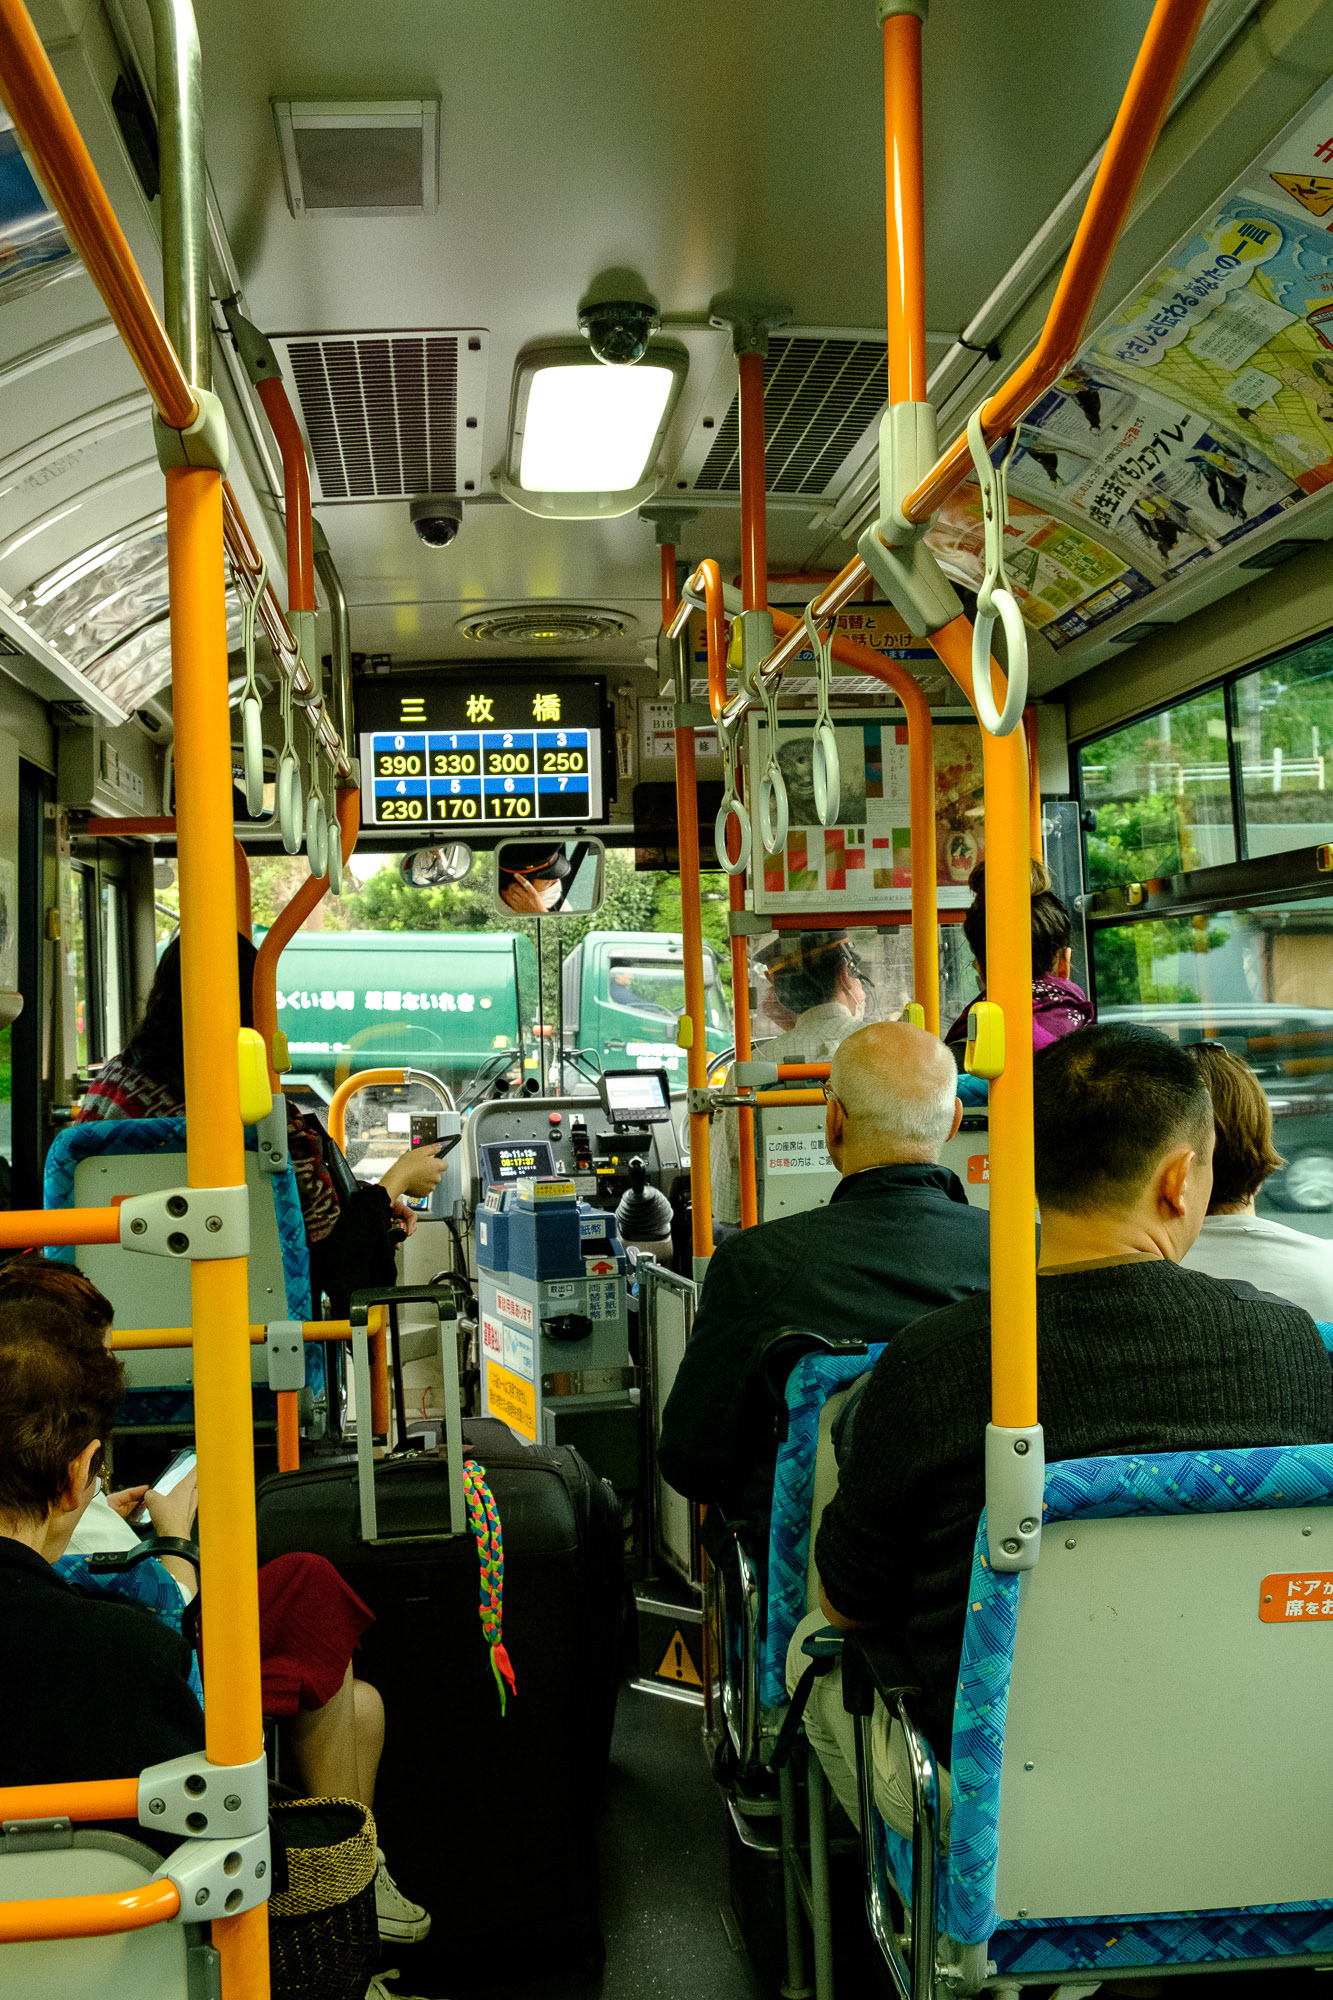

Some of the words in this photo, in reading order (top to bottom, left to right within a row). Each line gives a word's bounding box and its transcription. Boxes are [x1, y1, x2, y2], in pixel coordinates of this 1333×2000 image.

[842, 633, 914, 647] 話しかけ
[400, 693, 562, 723] 三枚橋
[394, 736, 405, 749] 0
[450, 736, 458, 748] 1
[503, 734, 513, 748] 2
[557, 733, 567, 747] 3
[380, 755, 421, 775] 390
[434, 754, 475, 774] 330
[489, 753, 529, 773] 300
[543, 752, 583, 772] 250
[396, 781, 407, 795] 4
[450, 780, 461, 793] 5
[504, 778, 515, 792] 6
[558, 777, 568, 791] 7
[381, 800, 422, 820] 230
[436, 799, 476, 818] 170
[491, 798, 531, 817] 170
[768, 1140, 827, 1152] この座席は、位置
[550, 1284, 573, 1293] 取出口
[588, 1284, 601, 1319] 両替紙幣
[604, 1282, 617, 1318] 運賃紙幣
